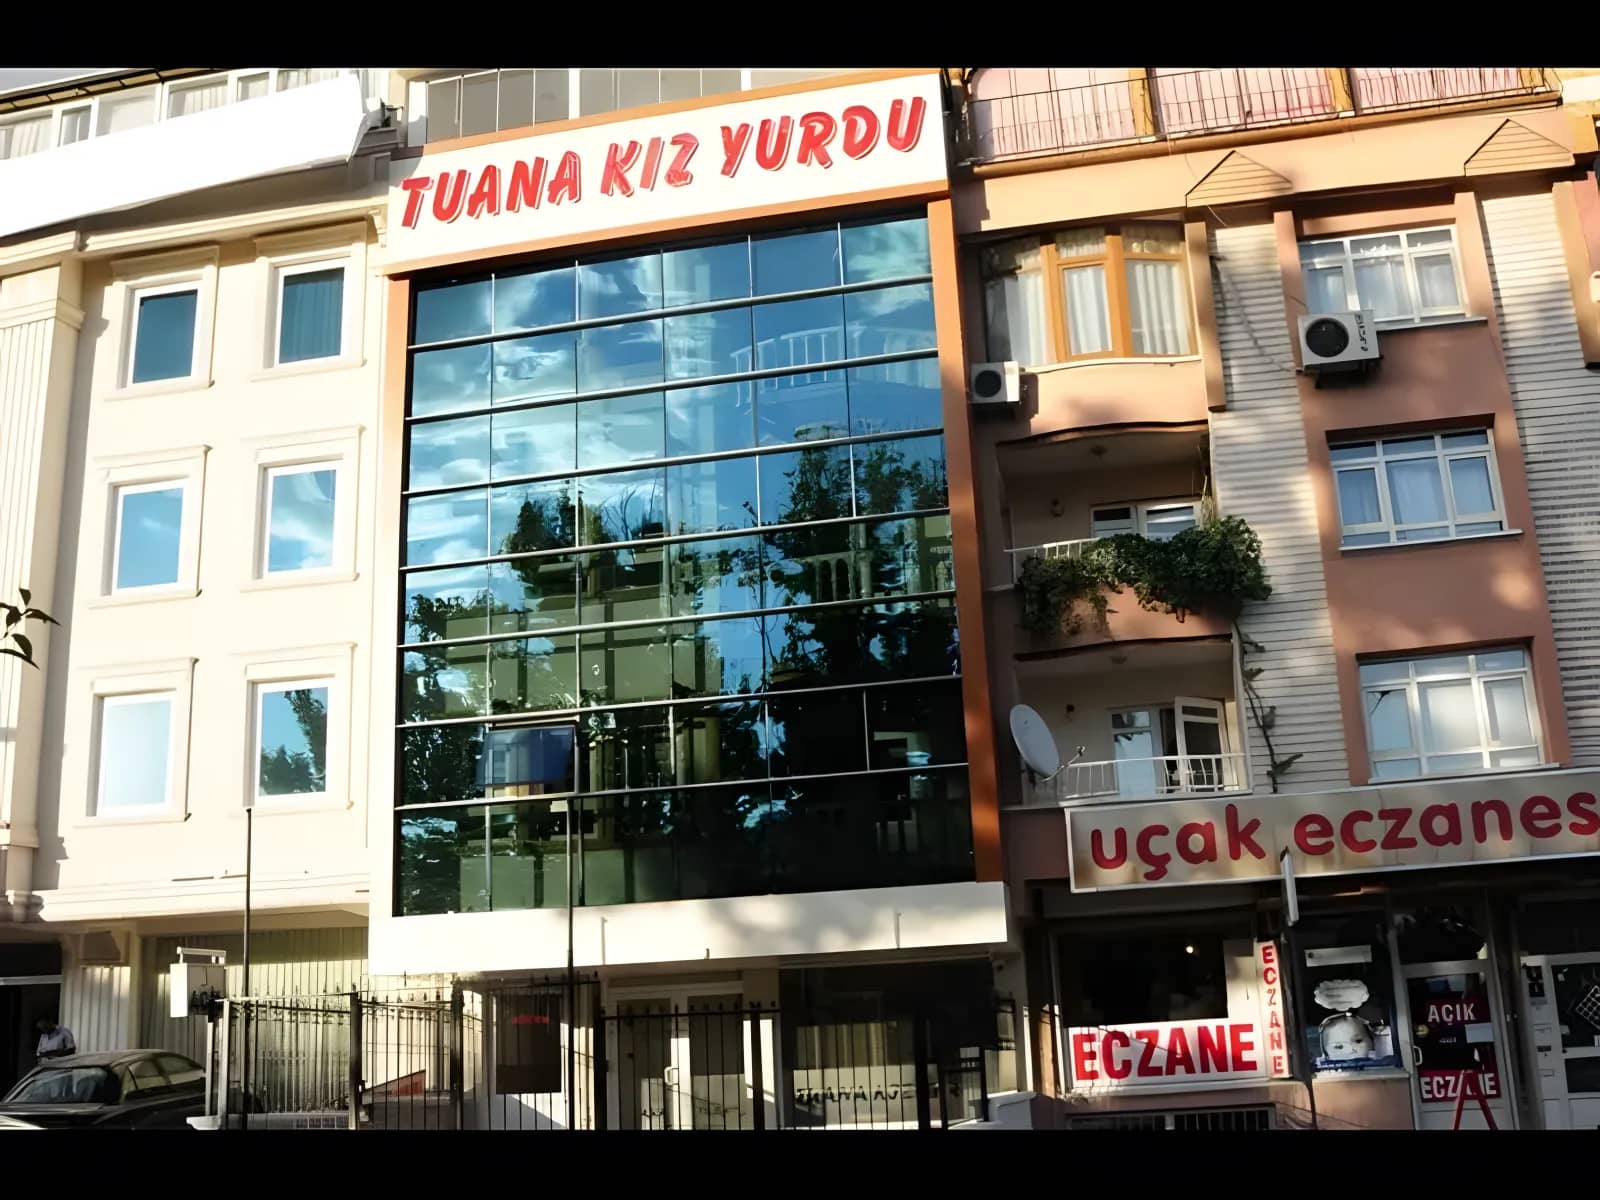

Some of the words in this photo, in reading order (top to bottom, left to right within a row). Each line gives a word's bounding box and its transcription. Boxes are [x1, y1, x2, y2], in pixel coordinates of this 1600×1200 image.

[401, 151, 582, 229] TUANA
[600, 132, 699, 197] KIZ
[720, 97, 926, 178] YURDU
[1091, 804, 1266, 880] uçak
[1294, 792, 1600, 854] eczanes
[1073, 1024, 1257, 1081] ECZANE
[1262, 945, 1284, 1075] ECZANE
[1427, 1003, 1476, 1026] AÇIK
